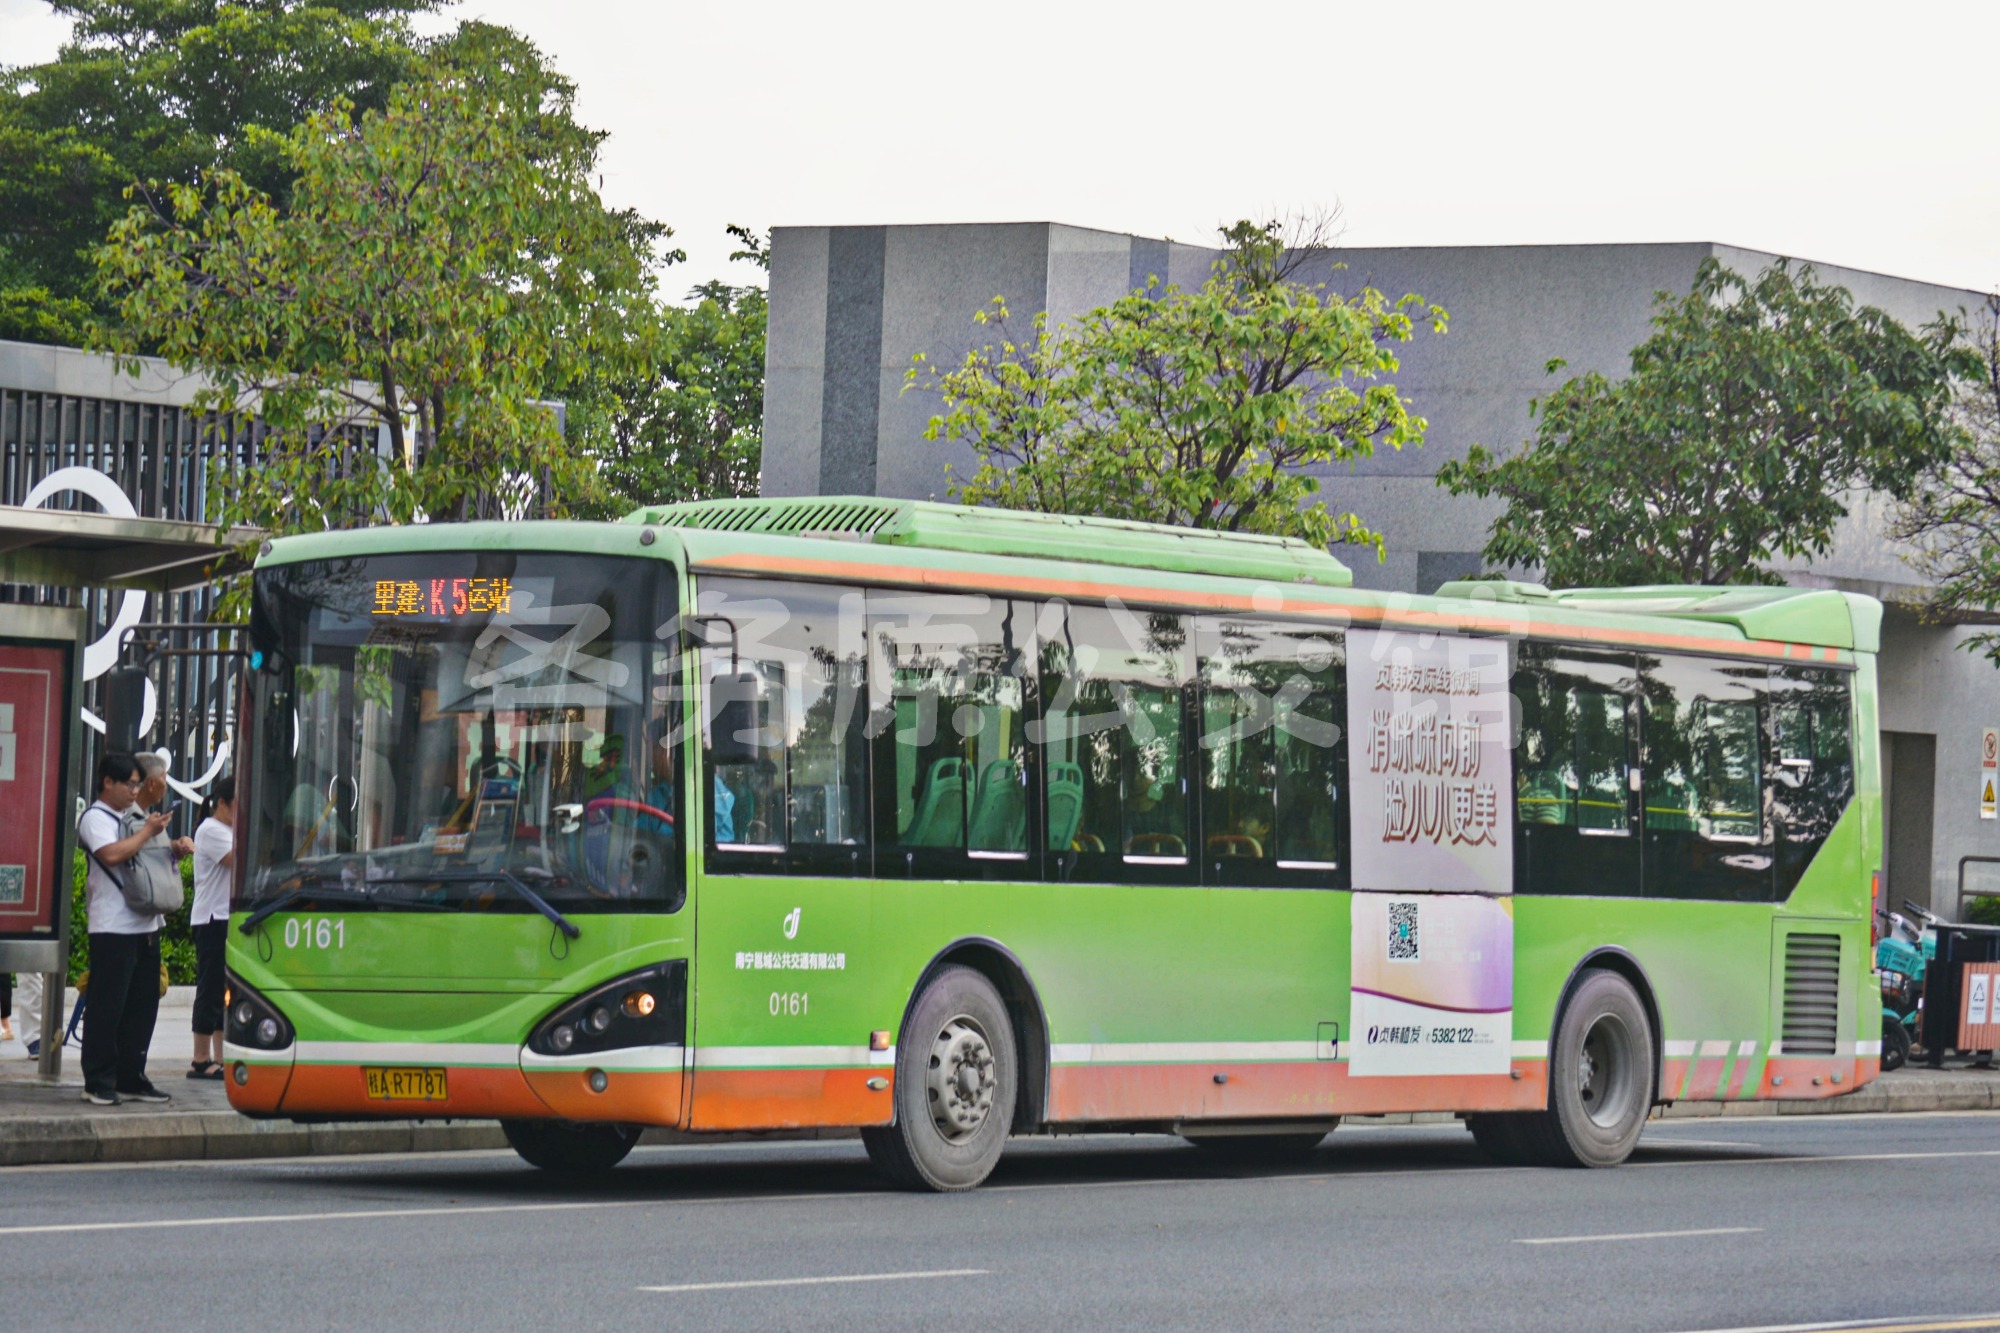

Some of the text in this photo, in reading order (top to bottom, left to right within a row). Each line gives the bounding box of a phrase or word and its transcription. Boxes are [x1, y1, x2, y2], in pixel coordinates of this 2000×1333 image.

[1382, 776, 1498, 848] 脸小小更美
[284, 917, 345, 949] 0161
[769, 991, 809, 1016] 0161
[1431, 1027, 1474, 1044] 5382122
